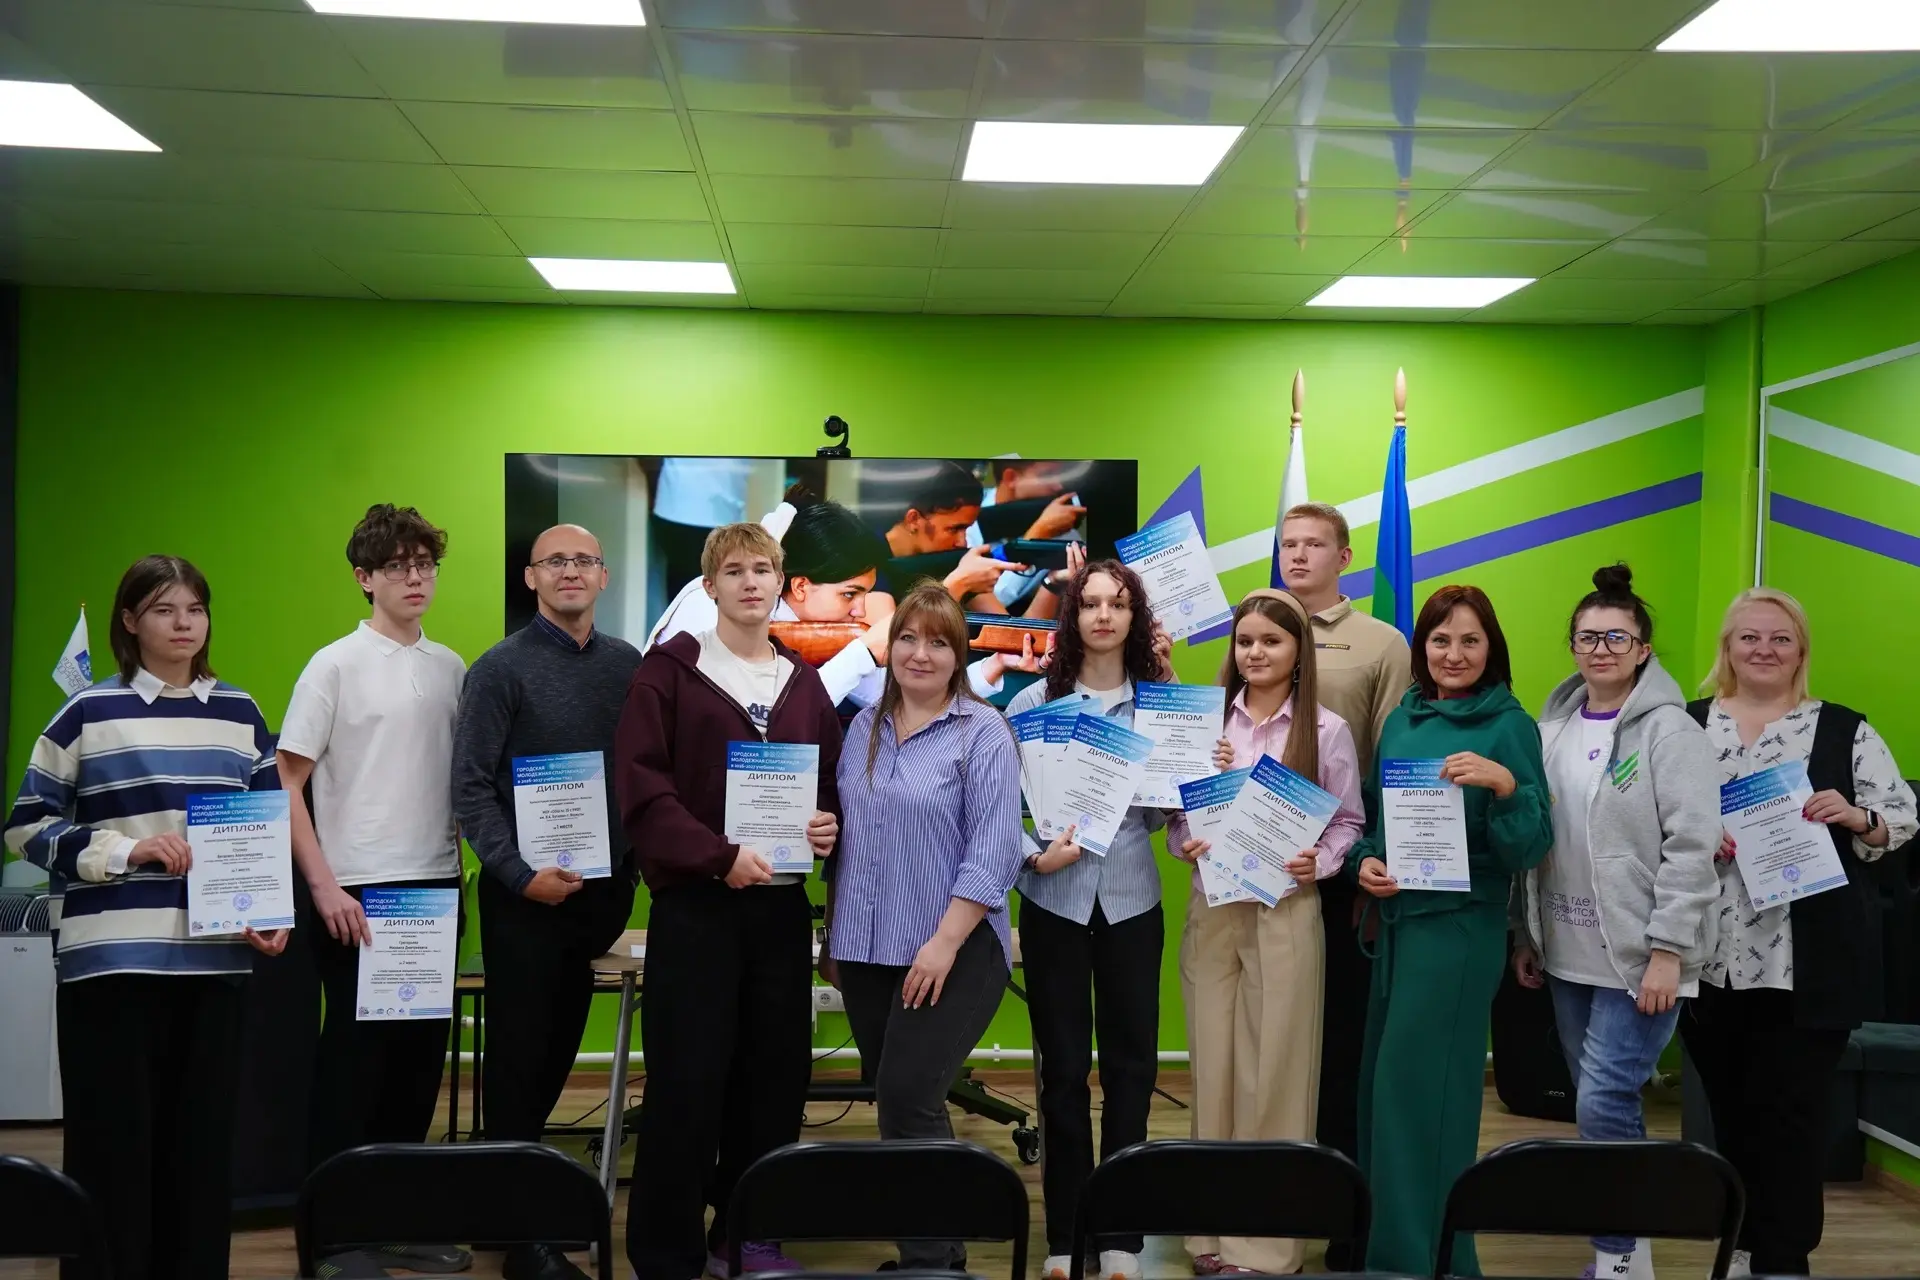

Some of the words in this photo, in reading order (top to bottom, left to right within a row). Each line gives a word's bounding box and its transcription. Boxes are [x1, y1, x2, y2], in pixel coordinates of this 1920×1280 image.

[1121, 540, 1145, 552] ГОРОДСКАЯ
[1143, 544, 1184, 565] ДИПЛОМ
[1156, 713, 1202, 721] ДИПЛОМ
[1078, 723, 1104, 735] ГОРОДСКАЯ
[1087, 747, 1128, 768] ДИПЛОМ
[1260, 764, 1285, 781] ГОРОДСКАЯ
[536, 783, 584, 793] ДИПЛОМ
[1184, 787, 1211, 798] ГОРОДСКАЯ
[1721, 789, 1746, 800] ОРОДСКАЯ
[1207, 802, 1232, 814] ДИП
[1263, 792, 1307, 820] ДИПЛОМ
[1743, 795, 1791, 817] ДИПЛОМ
[212, 824, 267, 834] ДИПЛОМ
[1571, 896, 1590, 906] где
[1555, 910, 1600, 927] большог
